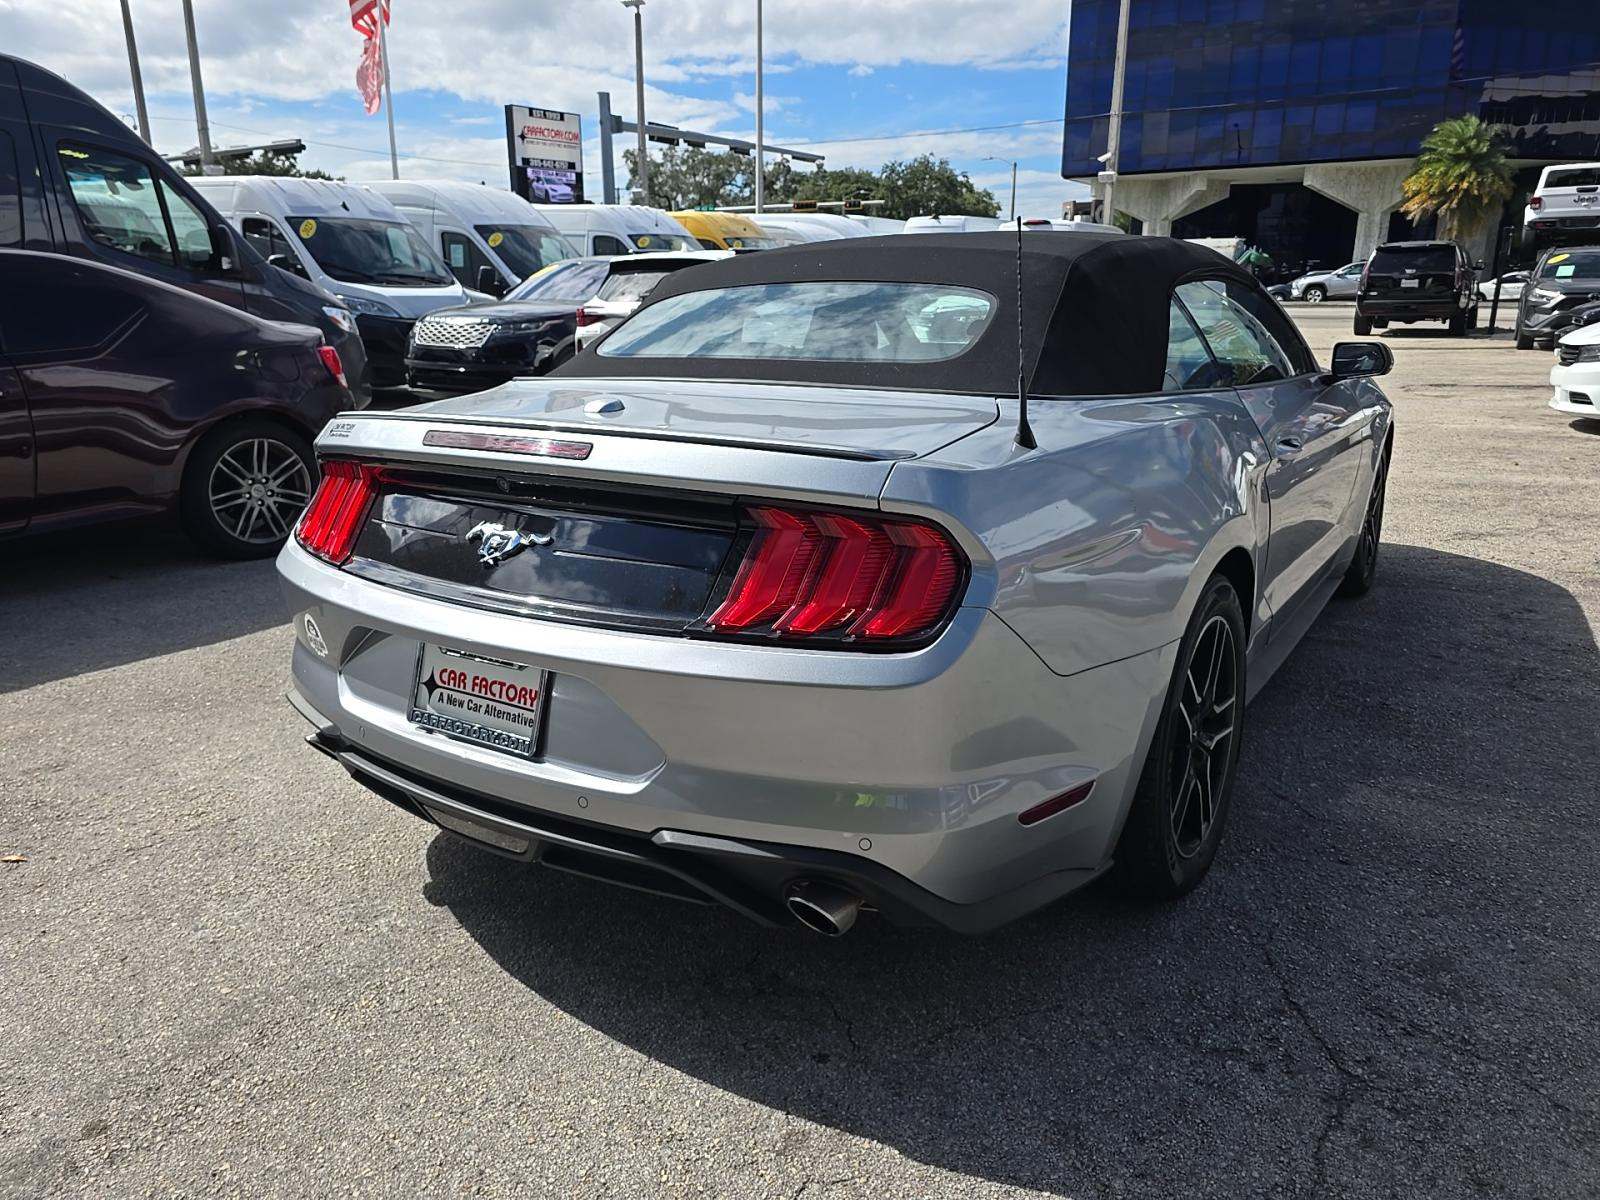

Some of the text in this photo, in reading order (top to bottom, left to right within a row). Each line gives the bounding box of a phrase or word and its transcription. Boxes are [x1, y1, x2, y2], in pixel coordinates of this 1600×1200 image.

[1573, 195, 1598, 203] Jeep
[438, 668, 539, 707] CAR FACTORY
[437, 692, 535, 728] A New Car Alternative
[412, 710, 532, 754] CARFACTORY.COM
